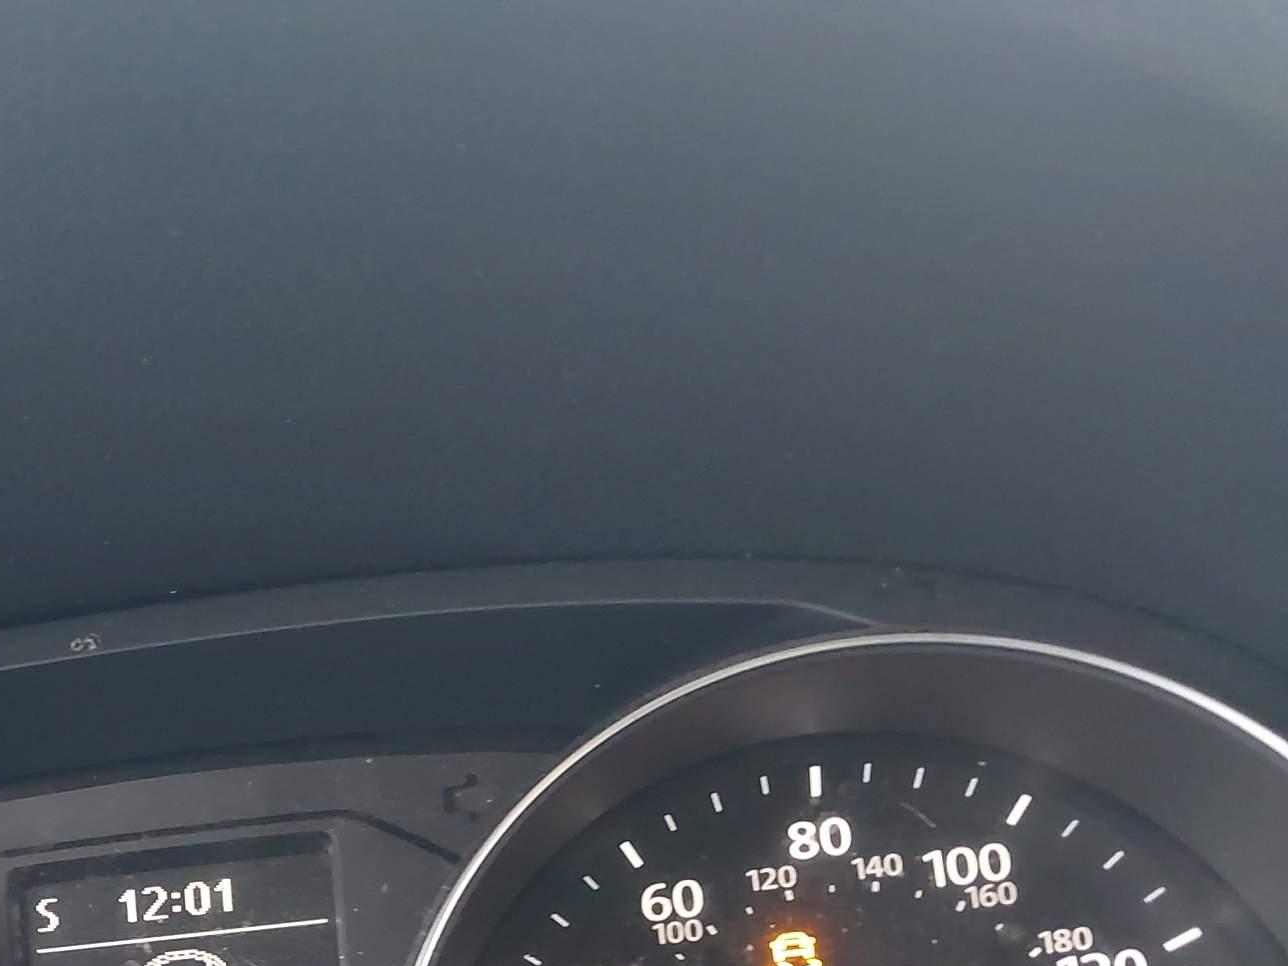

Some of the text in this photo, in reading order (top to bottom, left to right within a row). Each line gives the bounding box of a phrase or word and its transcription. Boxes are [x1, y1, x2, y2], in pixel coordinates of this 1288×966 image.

[787, 816, 852, 860] 80
[745, 865, 797, 891] 120
[850, 853, 903, 880] 140
[921, 842, 1011, 889] 100
[118, 878, 234, 923] 12:01
[641, 879, 704, 922] 60
[969, 880, 1018, 908] 160
[35, 898, 60, 933] S
[651, 918, 704, 945] 100
[1041, 926, 1094, 953] 180
